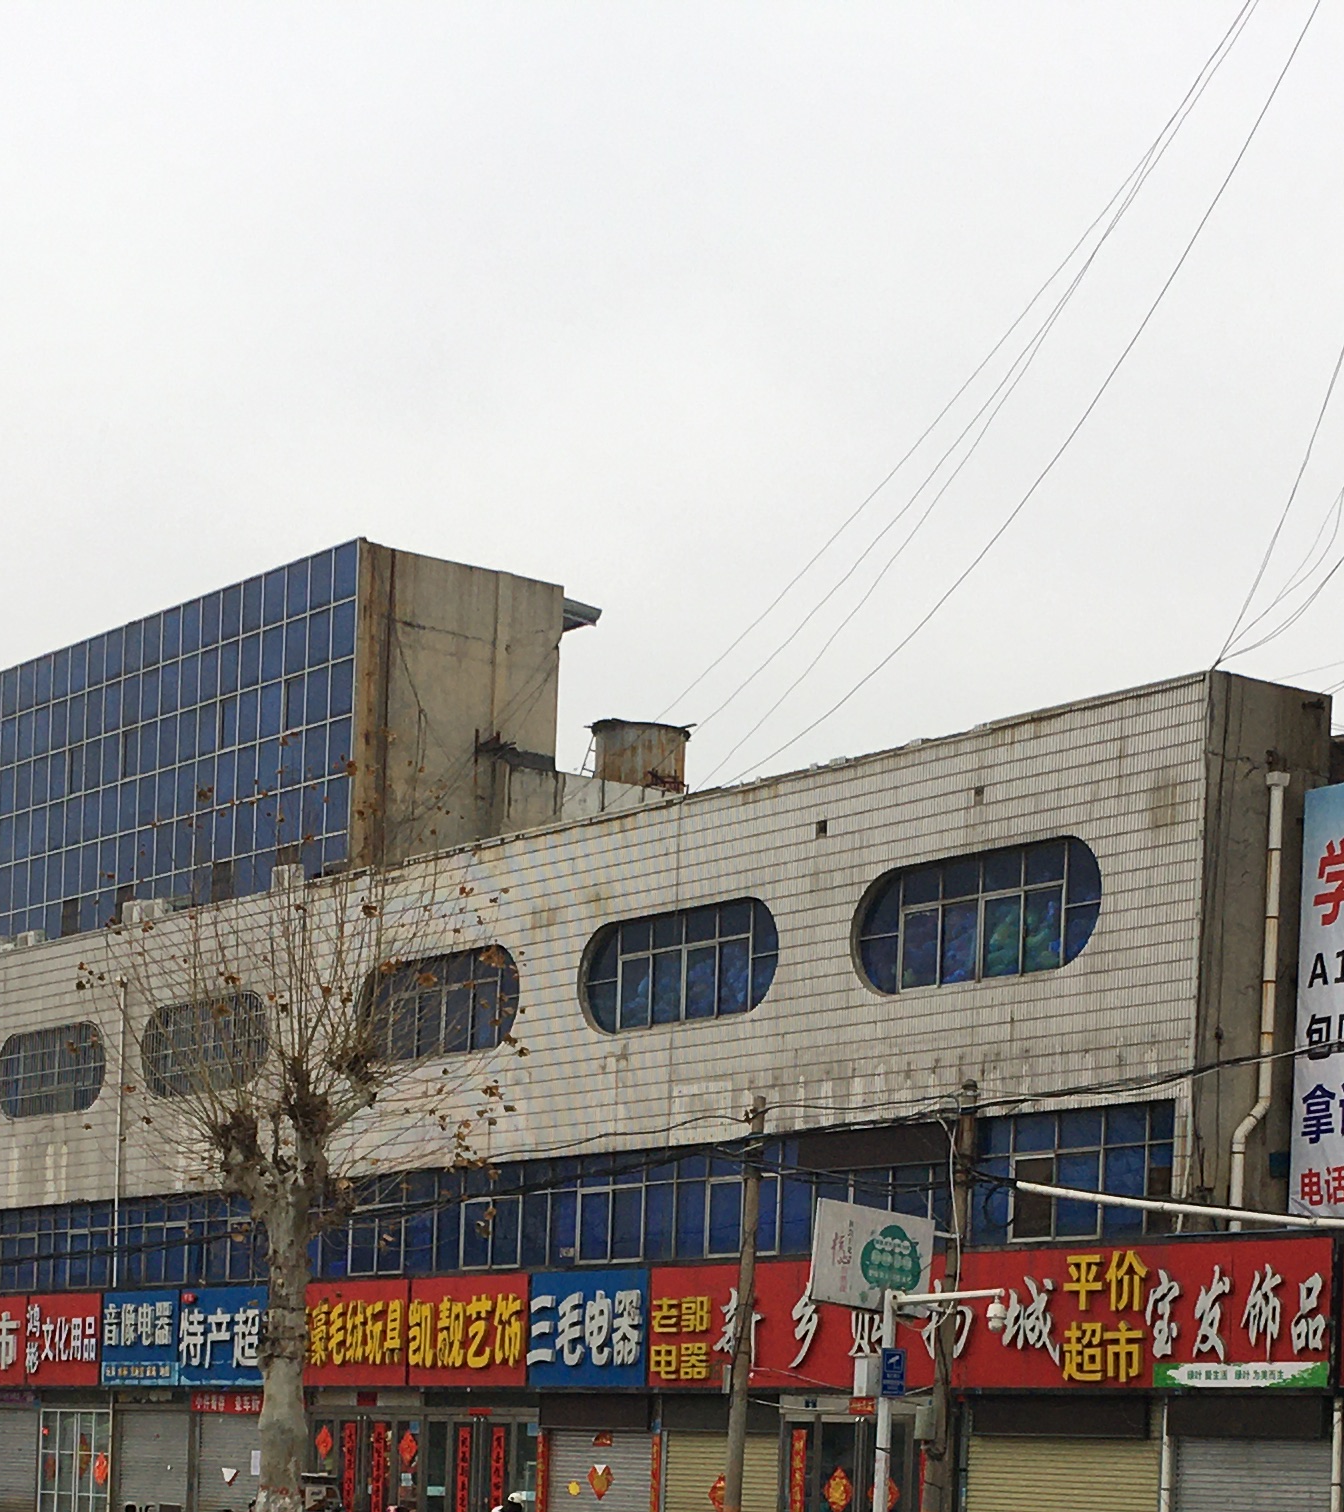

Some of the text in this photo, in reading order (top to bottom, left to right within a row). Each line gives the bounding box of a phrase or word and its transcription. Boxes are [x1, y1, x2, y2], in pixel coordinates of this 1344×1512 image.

[1063, 1250, 1150, 1312] 平价
[41, 1316, 97, 1361] 文化用品
[179, 1307, 269, 1369] 特产超
[305, 1299, 404, 1367] 豪毛绒玩具
[408, 1293, 524, 1368] 凯靓艺饰
[527, 1289, 643, 1367] 三毛电器
[651, 1296, 711, 1333] 老郭
[1144, 1263, 1331, 1363] 宝发饰品
[650, 1342, 710, 1380] 电器
[1062, 1321, 1146, 1383] 超市
